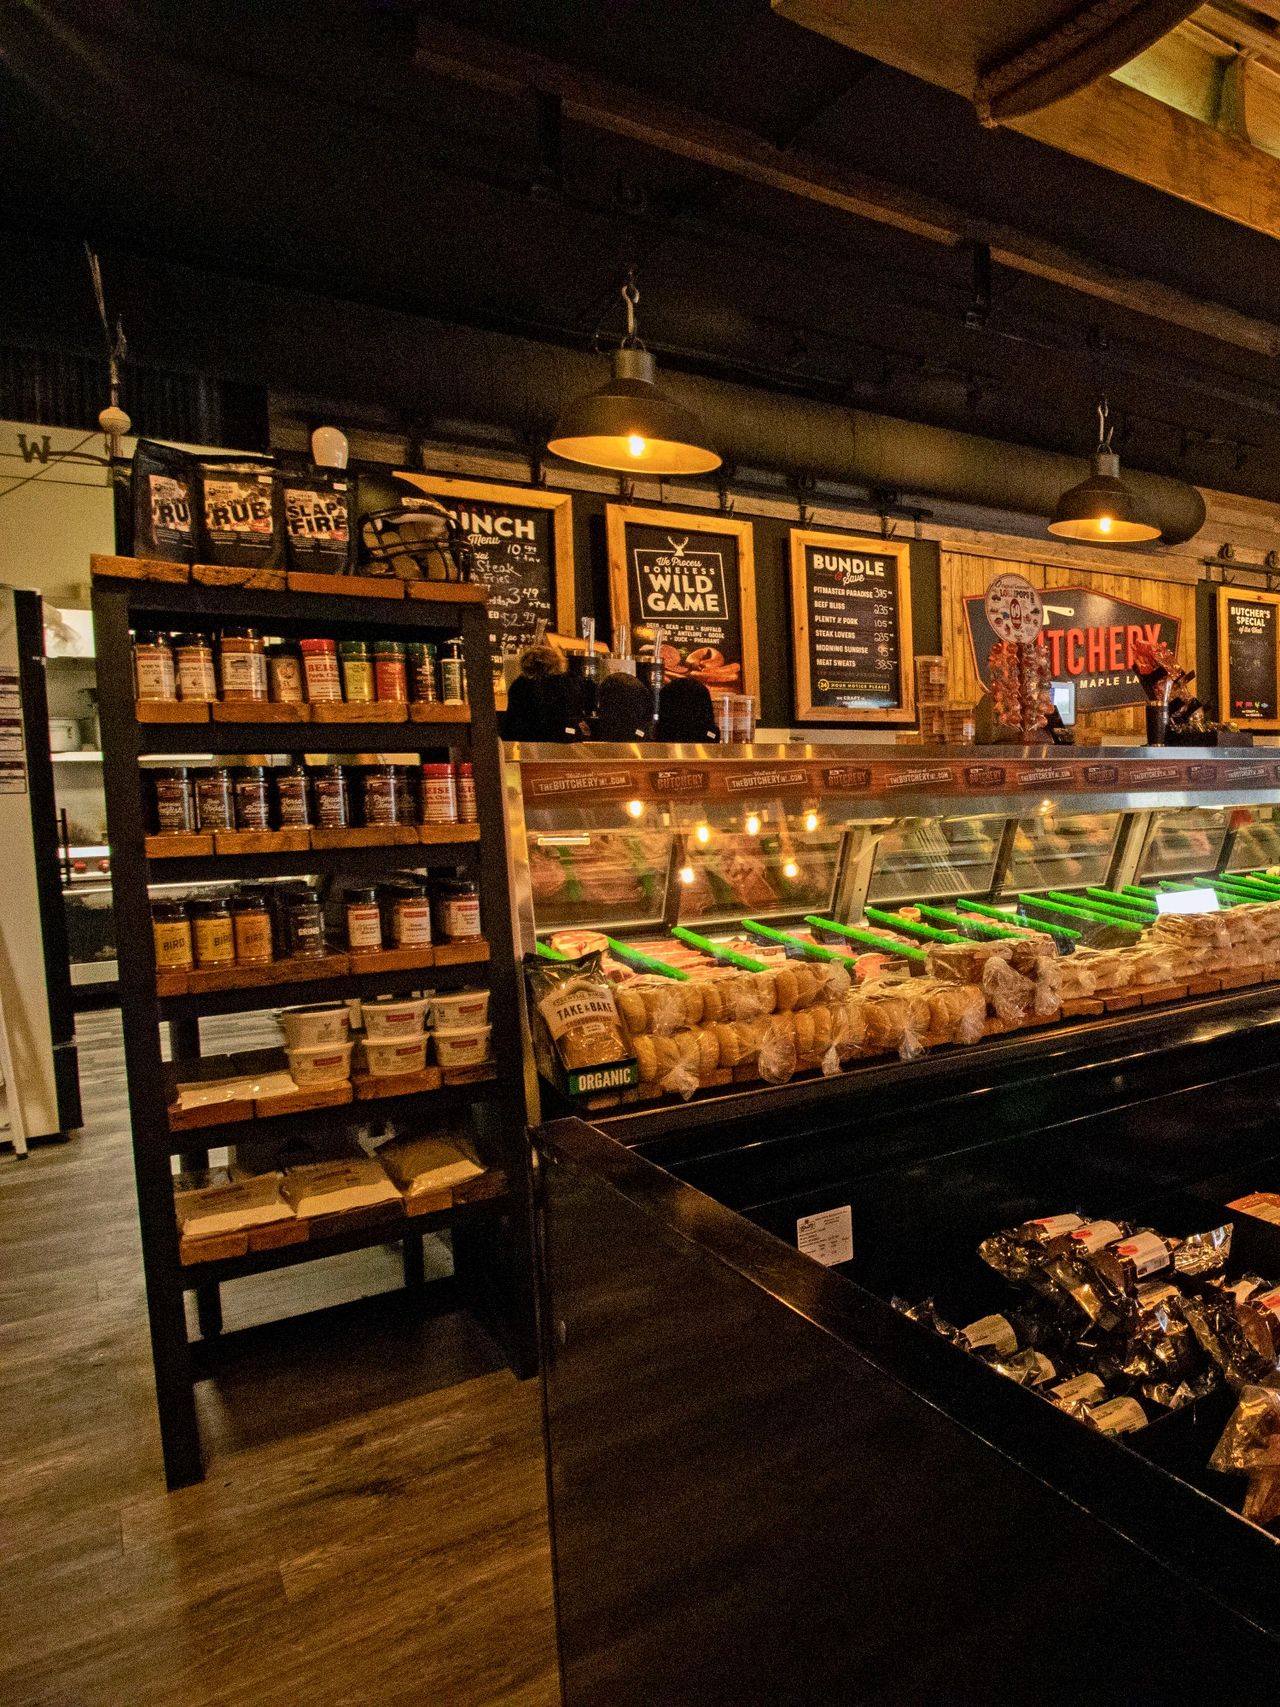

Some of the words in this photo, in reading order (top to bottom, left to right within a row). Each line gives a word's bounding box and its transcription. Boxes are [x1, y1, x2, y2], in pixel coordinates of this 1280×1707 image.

[17, 433, 51, 464] W
[157, 501, 191, 523] RU
[212, 502, 270, 526] RUB
[288, 502, 337, 519] SLAP
[290, 515, 348, 535] FIRE
[449, 510, 535, 540] UNCH
[467, 534, 501, 545] Menu
[475, 560, 522, 577] Steak
[656, 556, 671, 566] We
[671, 557, 702, 567] Process
[813, 553, 884, 576] BUNDLE
[643, 565, 715, 575] BONELESS
[648, 573, 713, 593] WILD
[843, 572, 865, 586] Save
[813, 586, 845, 596] PITMASTER
[846, 589, 873, 599] PARADISE
[647, 592, 720, 612] GAME
[1230, 606, 1271, 618] BUTCHER'S
[815, 615, 836, 624] PLENTY
[843, 617, 858, 625] PORK
[1236, 616, 1265, 627] SPECIAL
[815, 629, 833, 638] STEAK
[834, 631, 856, 639] LOVERS
[816, 643, 843, 652] MORNING
[1035, 623, 1162, 678] TCHERY
[816, 658, 832, 667] MEAT
[833, 659, 856, 668] SWEATS
[1079, 676, 1120, 688] MAPLE
[1126, 675, 1140, 684] LA
[163, 937, 185, 951] BIRD
[556, 1002, 584, 1020] TAKE
[591, 1001, 613, 1014] BAKE
[578, 1067, 631, 1092] ORGANIC
